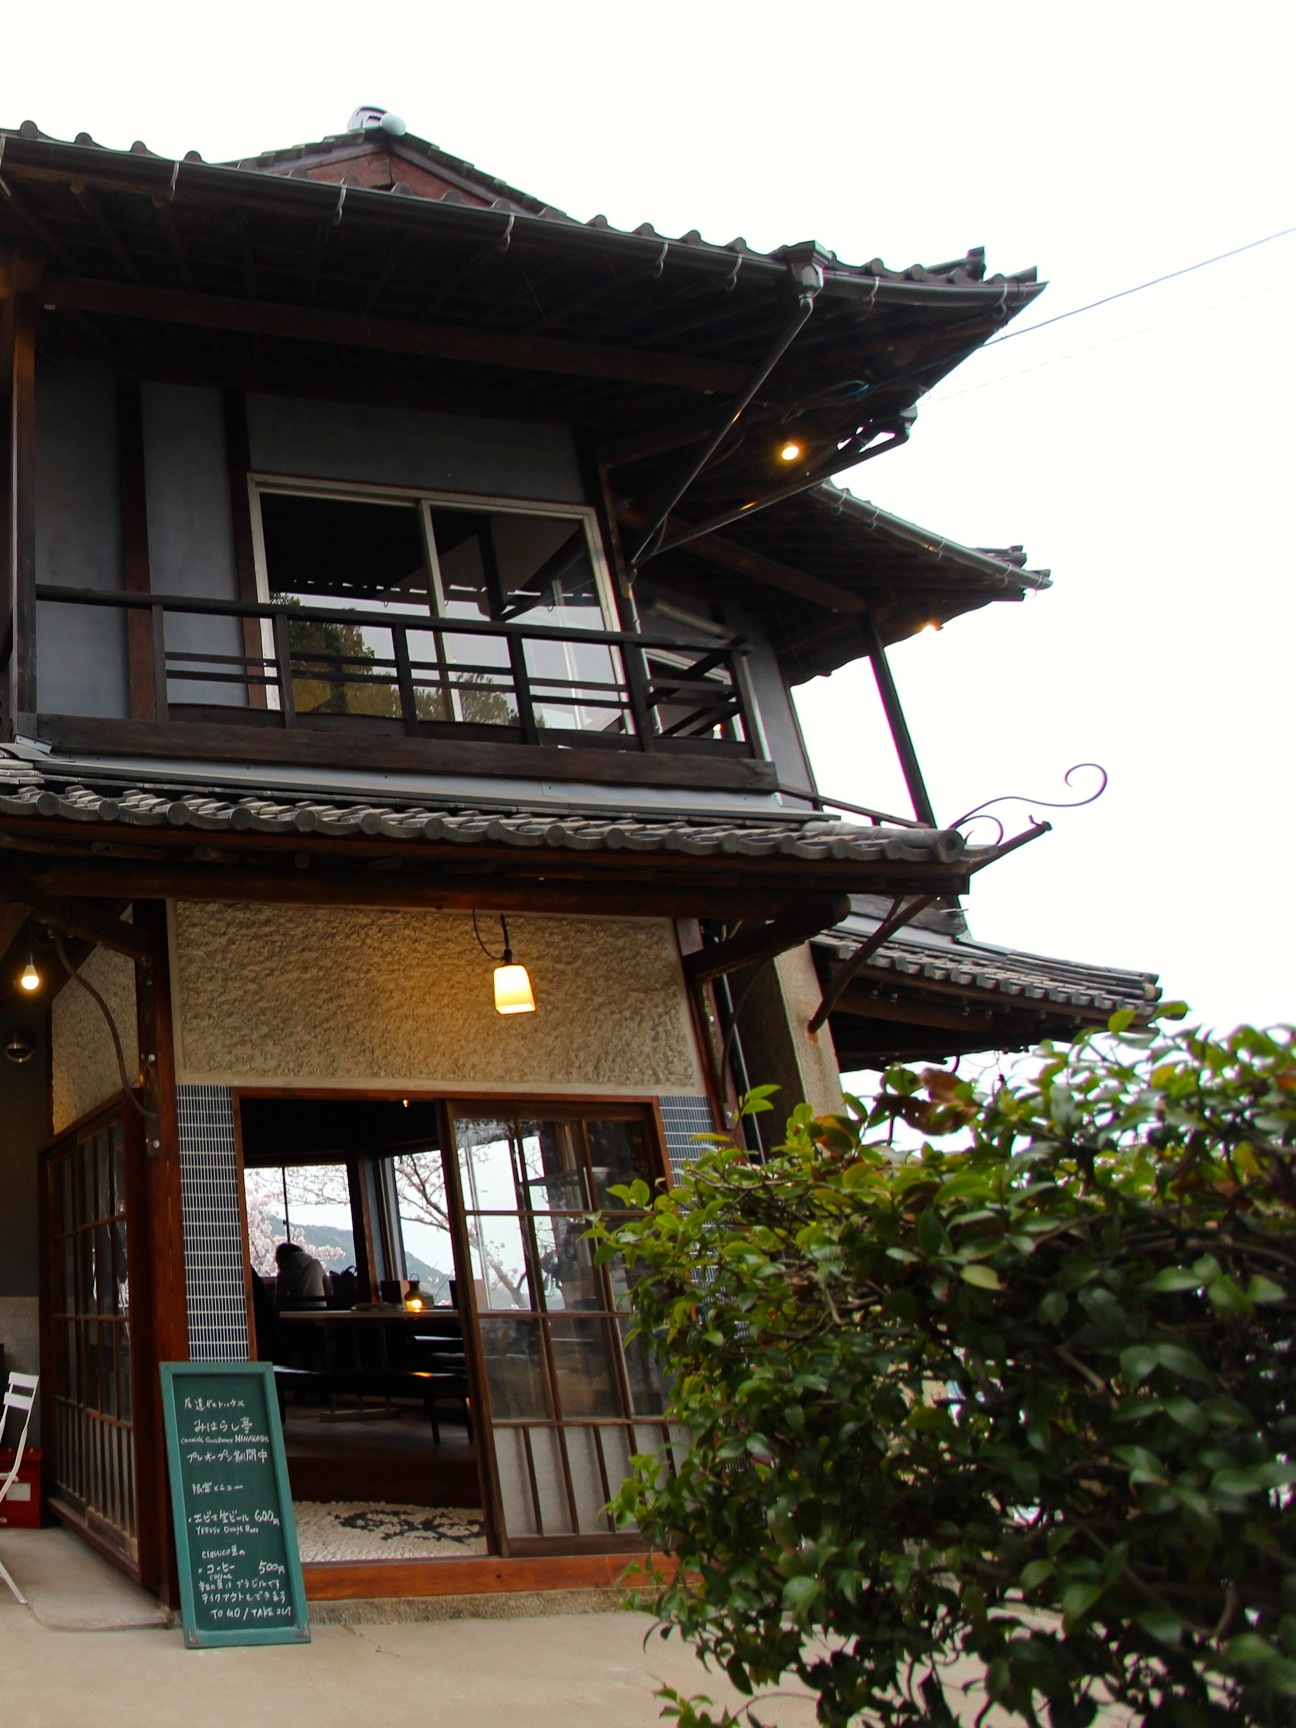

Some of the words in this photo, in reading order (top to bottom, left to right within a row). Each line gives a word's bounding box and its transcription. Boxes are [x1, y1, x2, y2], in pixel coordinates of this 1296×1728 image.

[194, 1417, 252, 1434] みはらし亭
[187, 1448, 268, 1464] プレオープン期間中
[251, 1606, 275, 1618] TAKE
